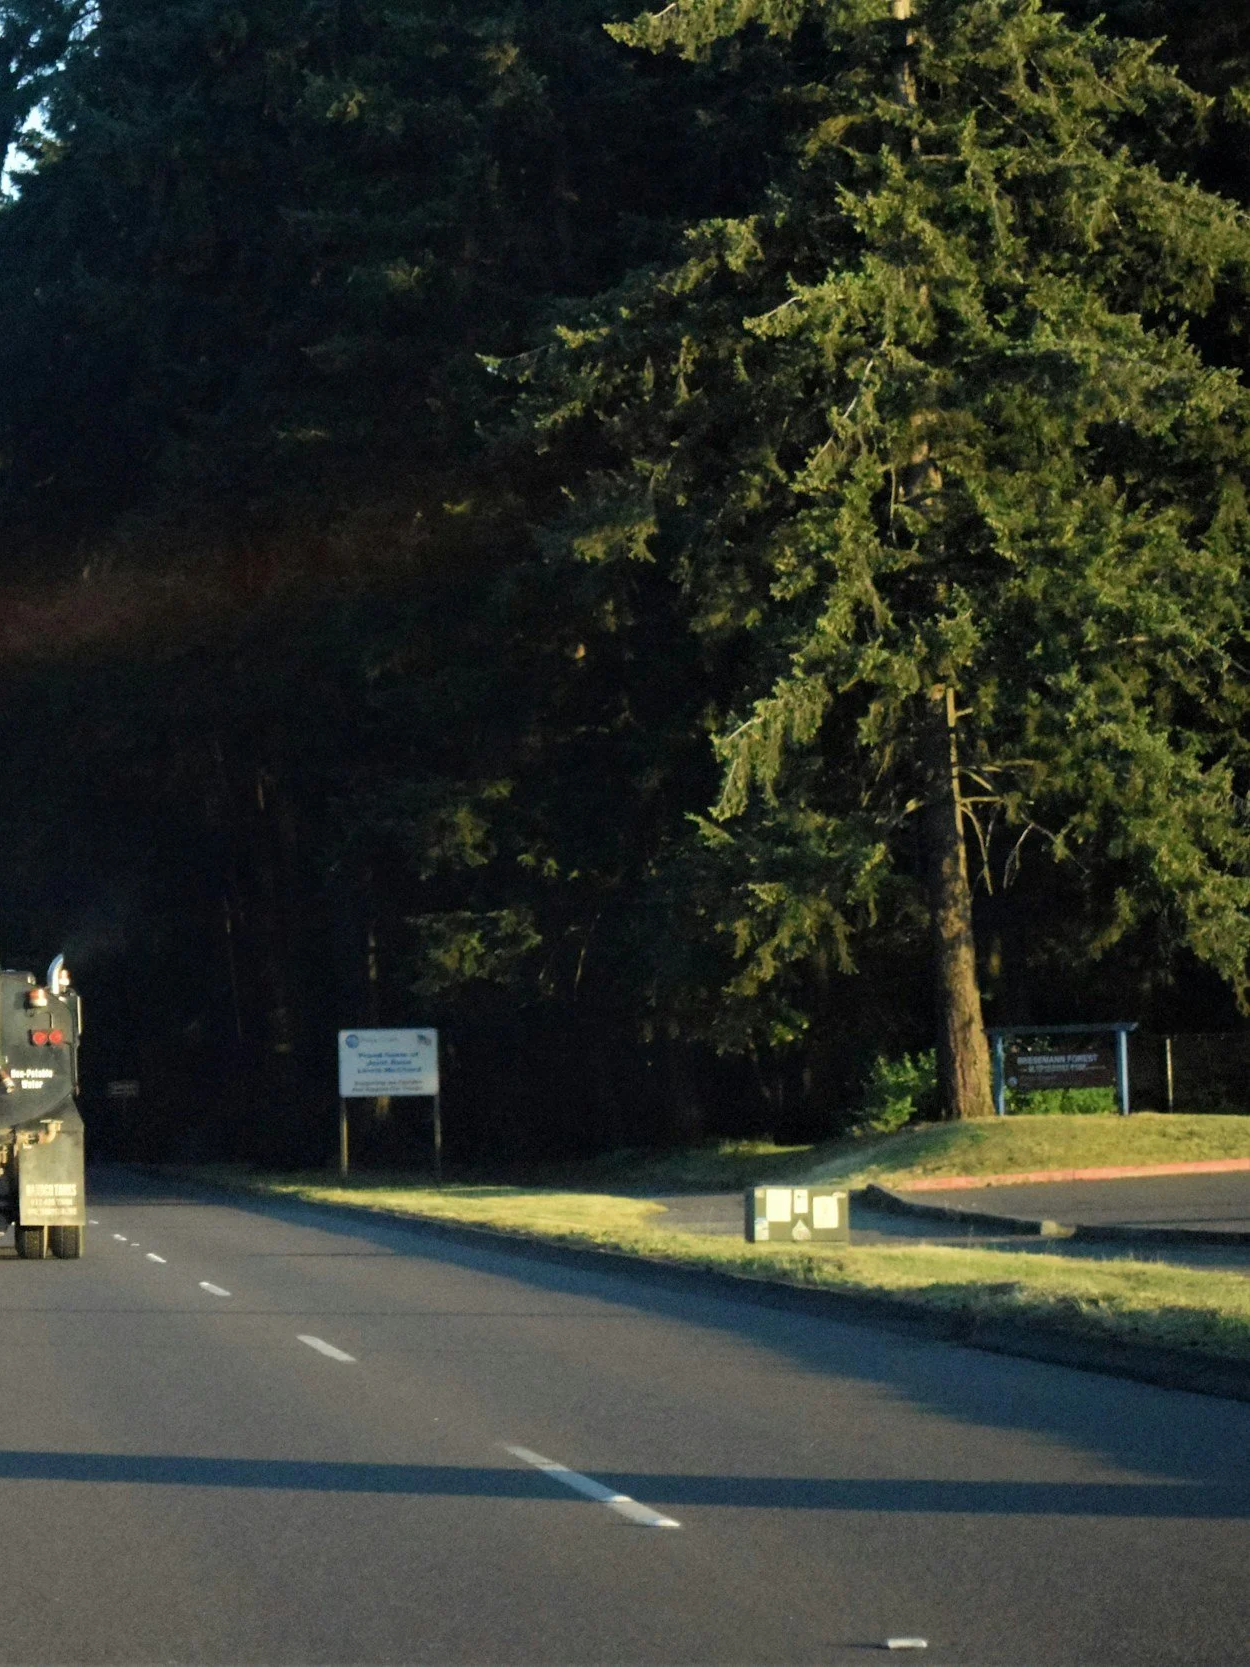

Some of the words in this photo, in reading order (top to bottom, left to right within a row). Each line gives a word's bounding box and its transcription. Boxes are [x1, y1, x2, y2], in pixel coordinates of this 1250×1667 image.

[1067, 1053, 1098, 1063] FOREST
[10, 1068, 53, 1078] Non-Potable
[21, 1080, 43, 1089] Water
